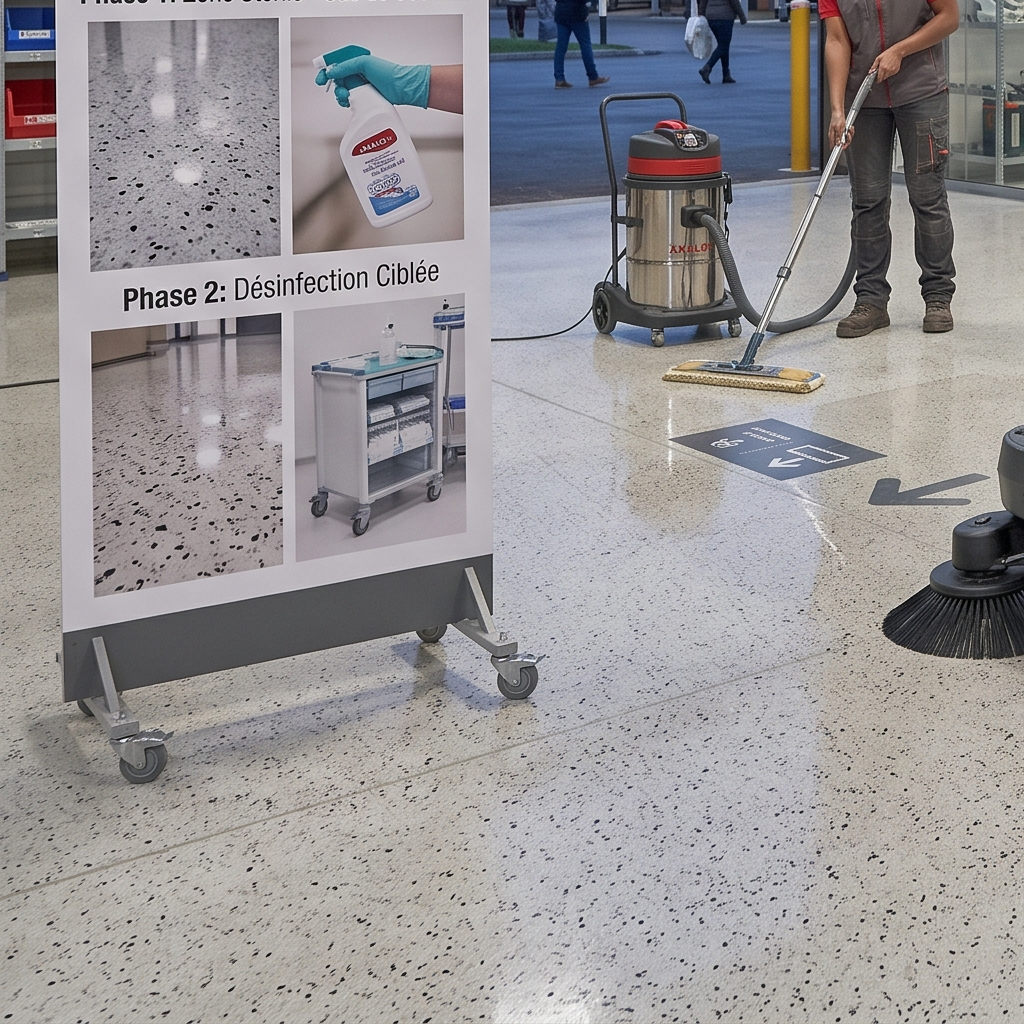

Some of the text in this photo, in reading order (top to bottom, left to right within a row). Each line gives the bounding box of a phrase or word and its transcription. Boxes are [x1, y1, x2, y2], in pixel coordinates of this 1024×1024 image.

[123, 259, 440, 312] Phase 2: Désinfection Ciblée
